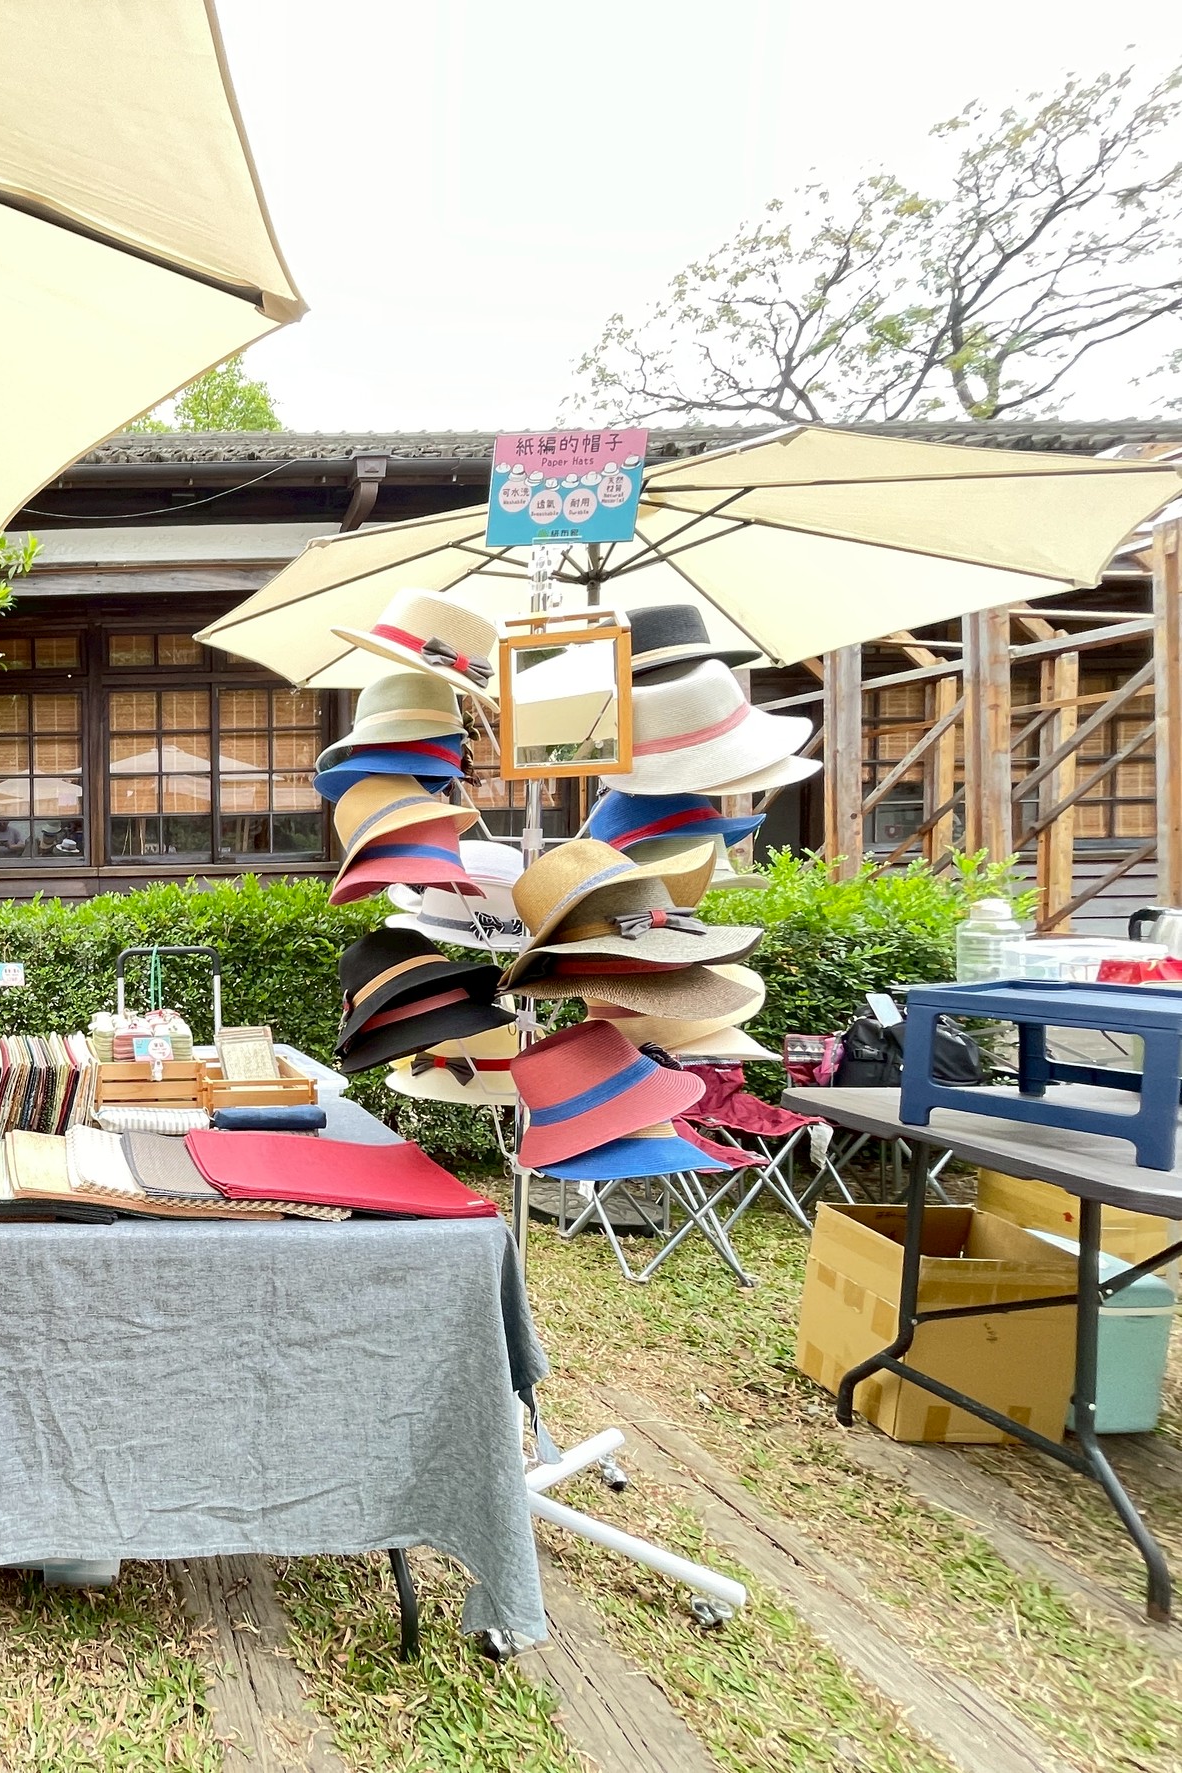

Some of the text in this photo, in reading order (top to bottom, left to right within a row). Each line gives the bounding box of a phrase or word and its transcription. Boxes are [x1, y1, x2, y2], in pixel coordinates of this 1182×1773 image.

[516, 433, 623, 456] 紙編的帽子
[541, 457, 594, 467] Paper Hats
[502, 488, 530, 497] 可水洗
